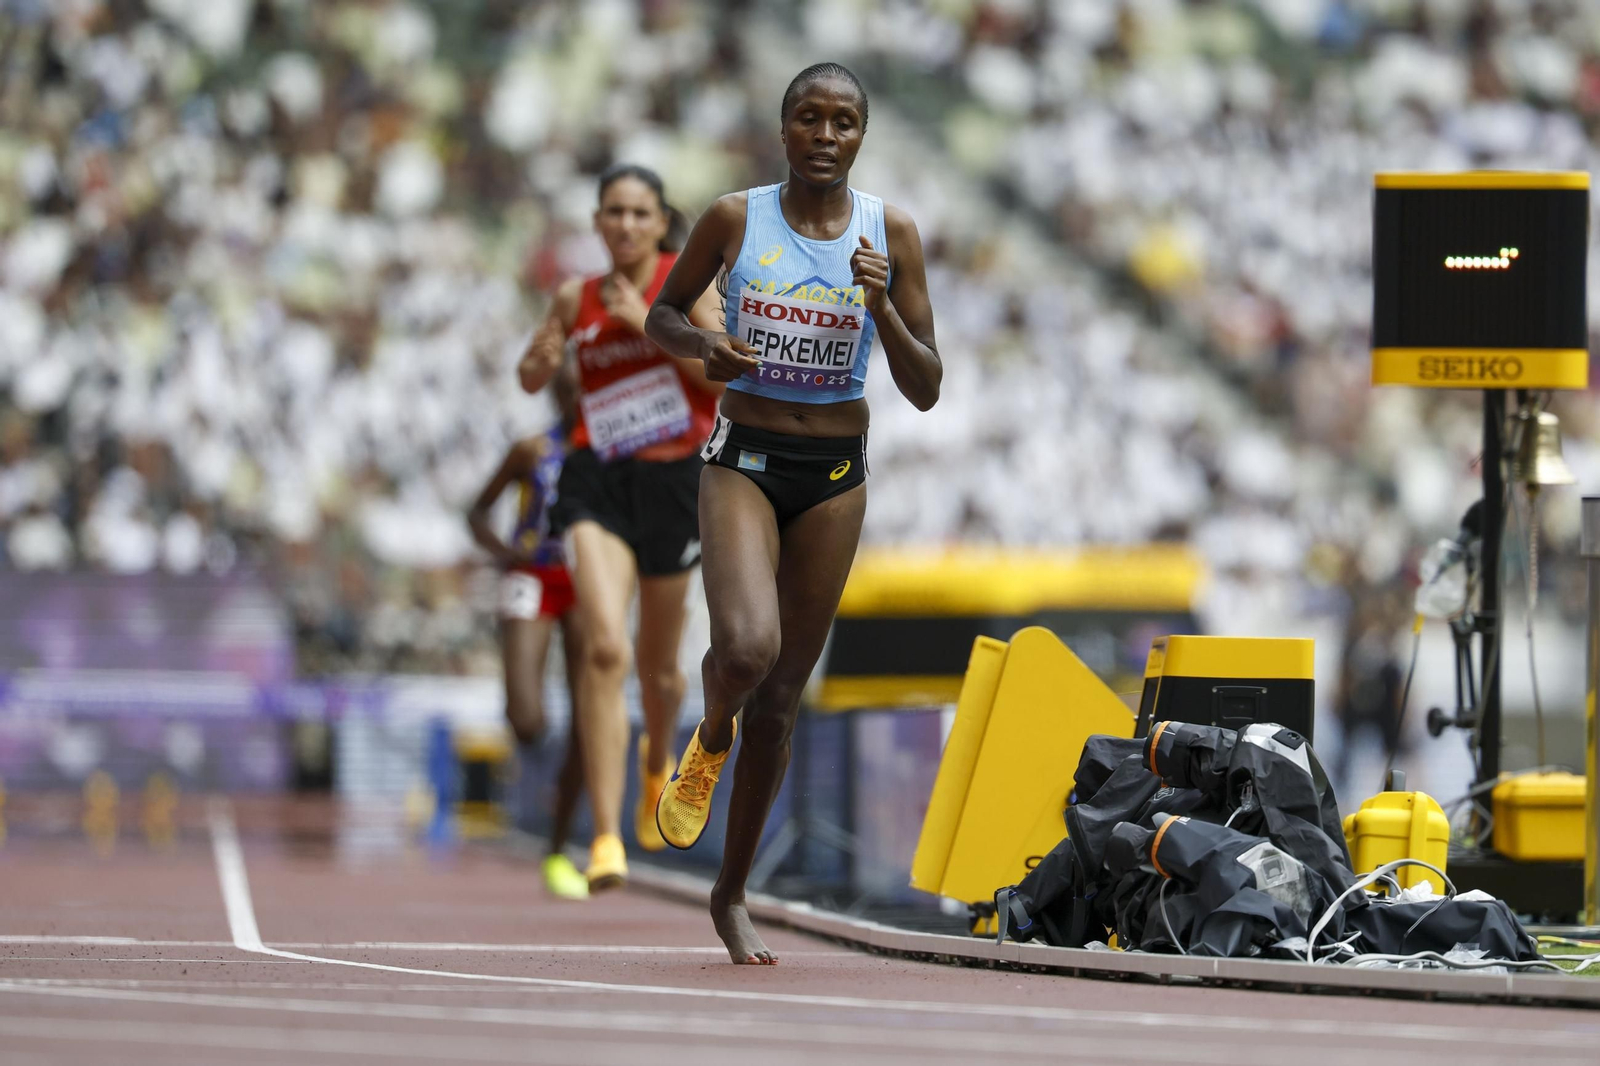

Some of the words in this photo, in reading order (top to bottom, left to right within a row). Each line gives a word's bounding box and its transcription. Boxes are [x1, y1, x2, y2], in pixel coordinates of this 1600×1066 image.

[746, 279, 866, 307] QAZAQSTA
[741, 296, 861, 330] HONDA
[1418, 355, 1524, 381] SEIKO
